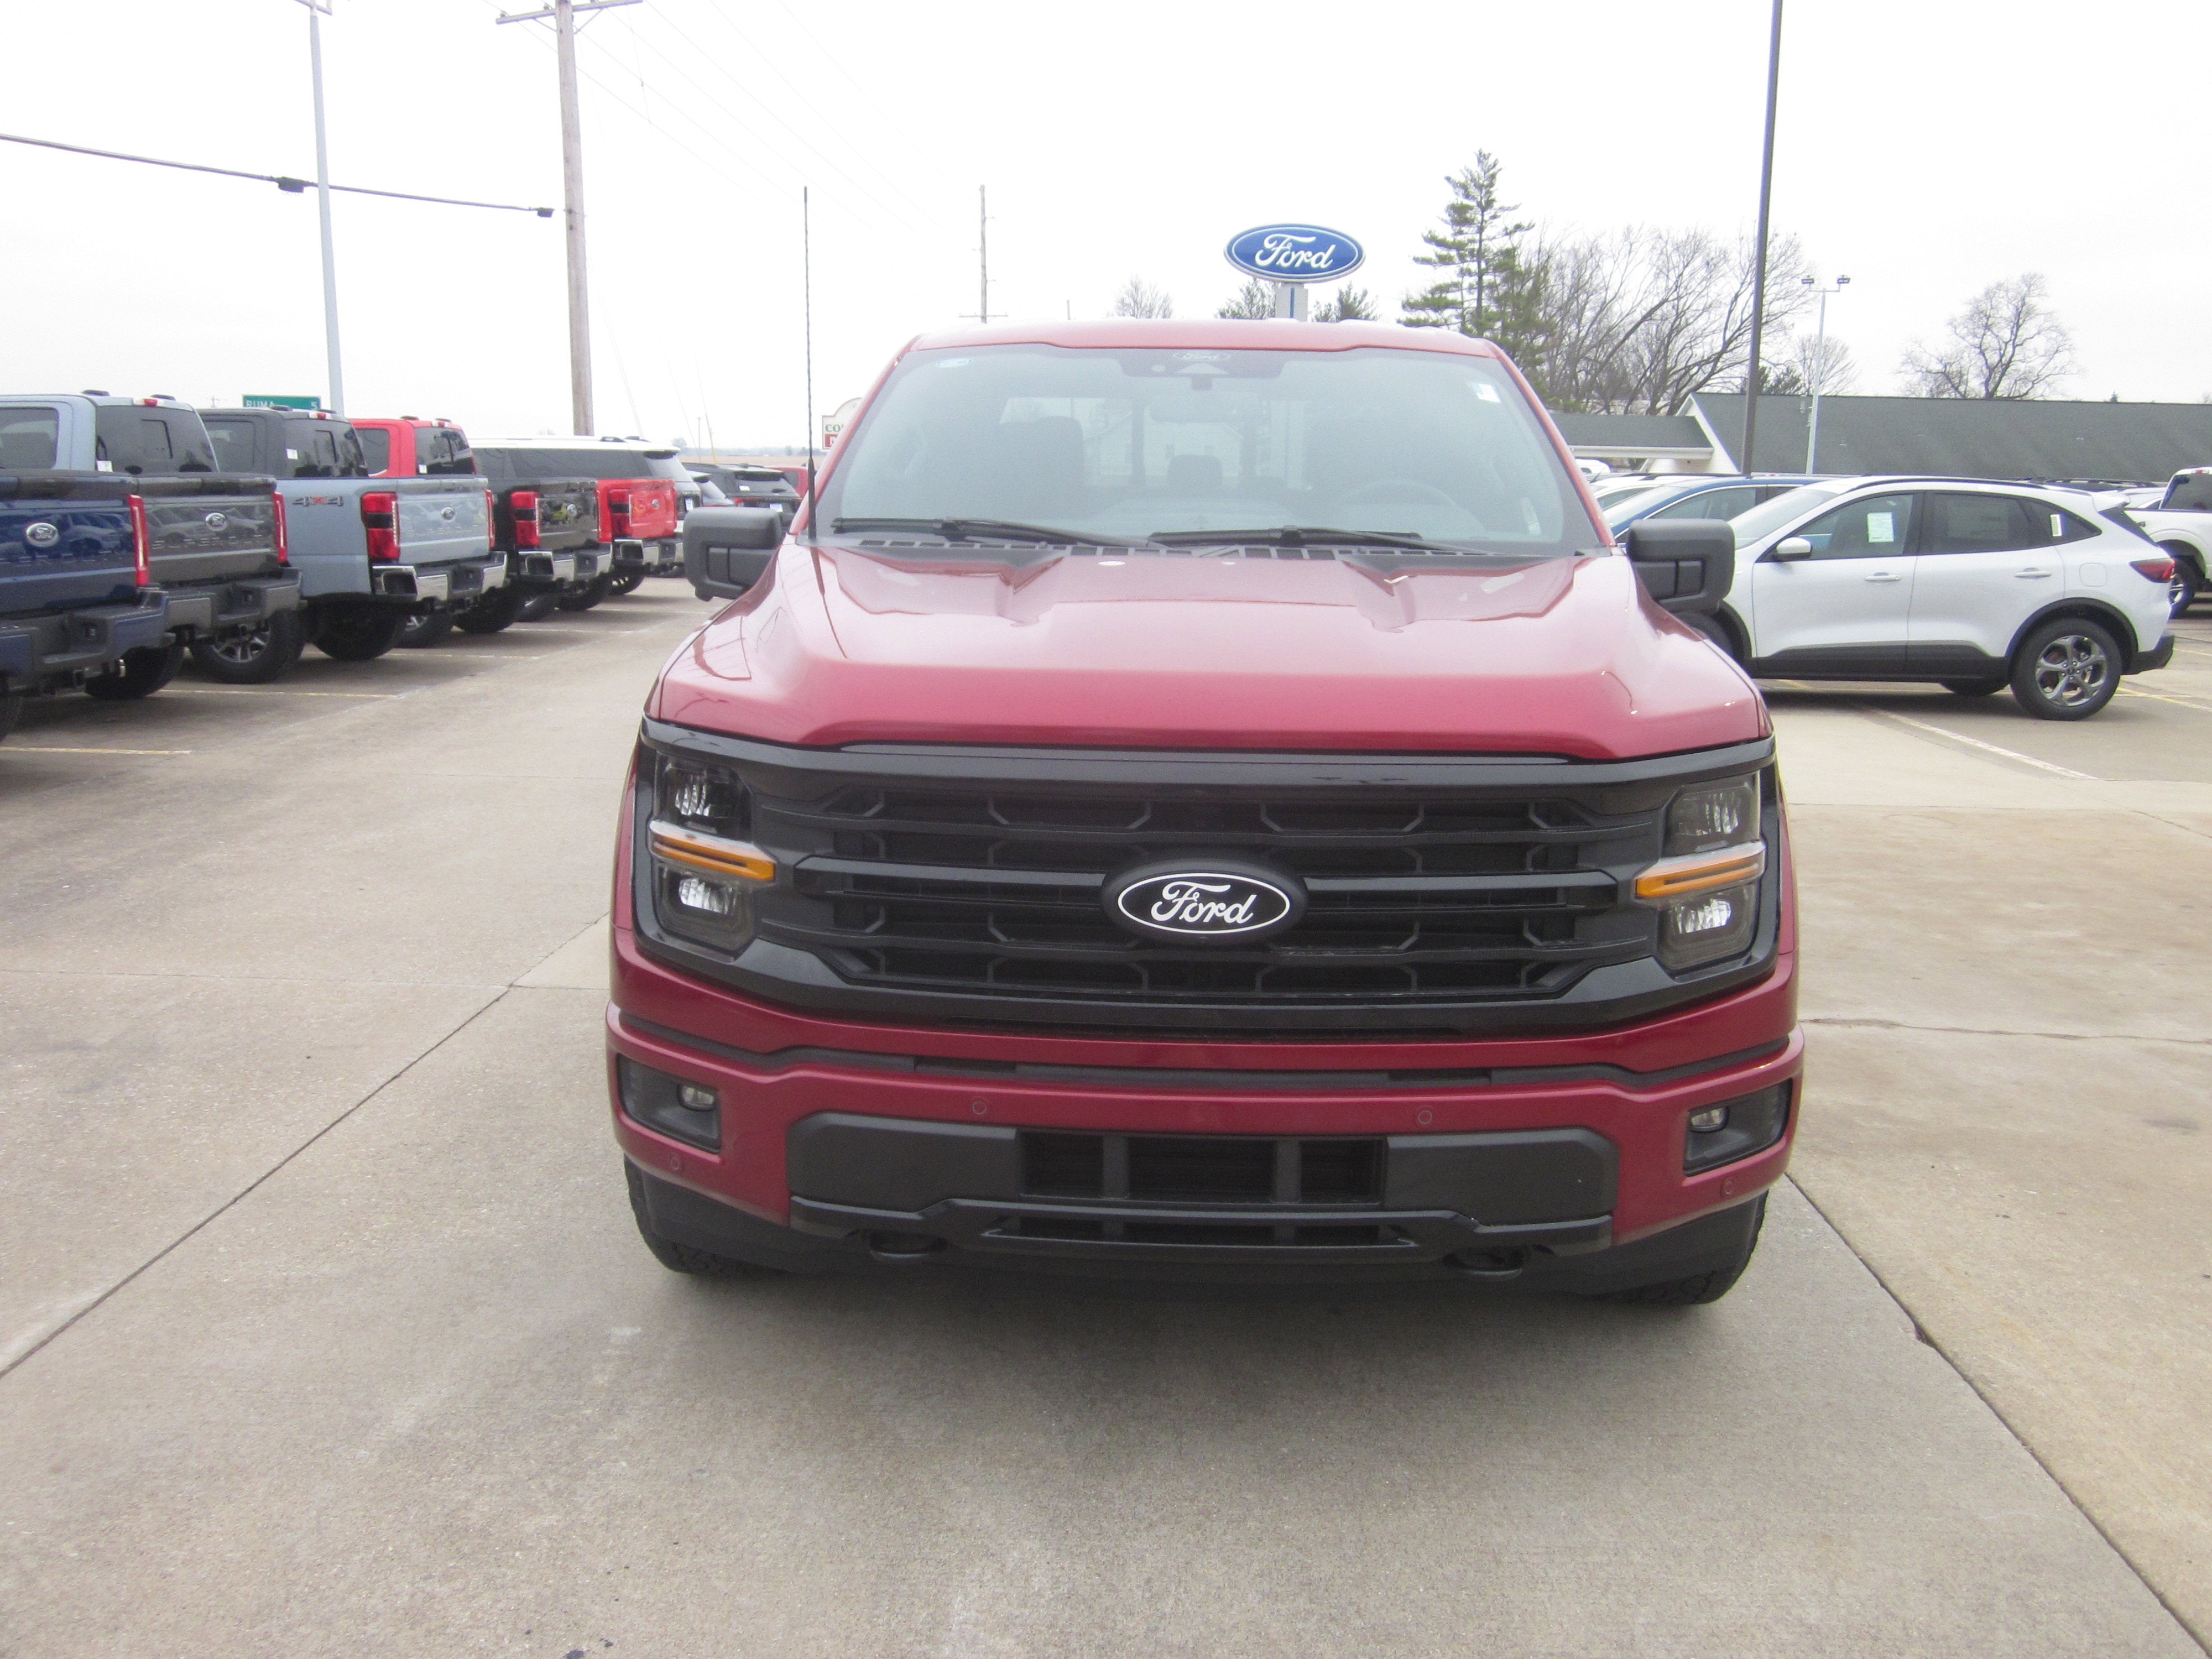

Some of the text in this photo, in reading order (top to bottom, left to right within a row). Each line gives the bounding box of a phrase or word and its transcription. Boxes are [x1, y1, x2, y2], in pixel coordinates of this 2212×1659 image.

[1254, 233, 1337, 269] Ford
[311, 401, 319, 409] 5
[1150, 880, 1258, 924] Ford
